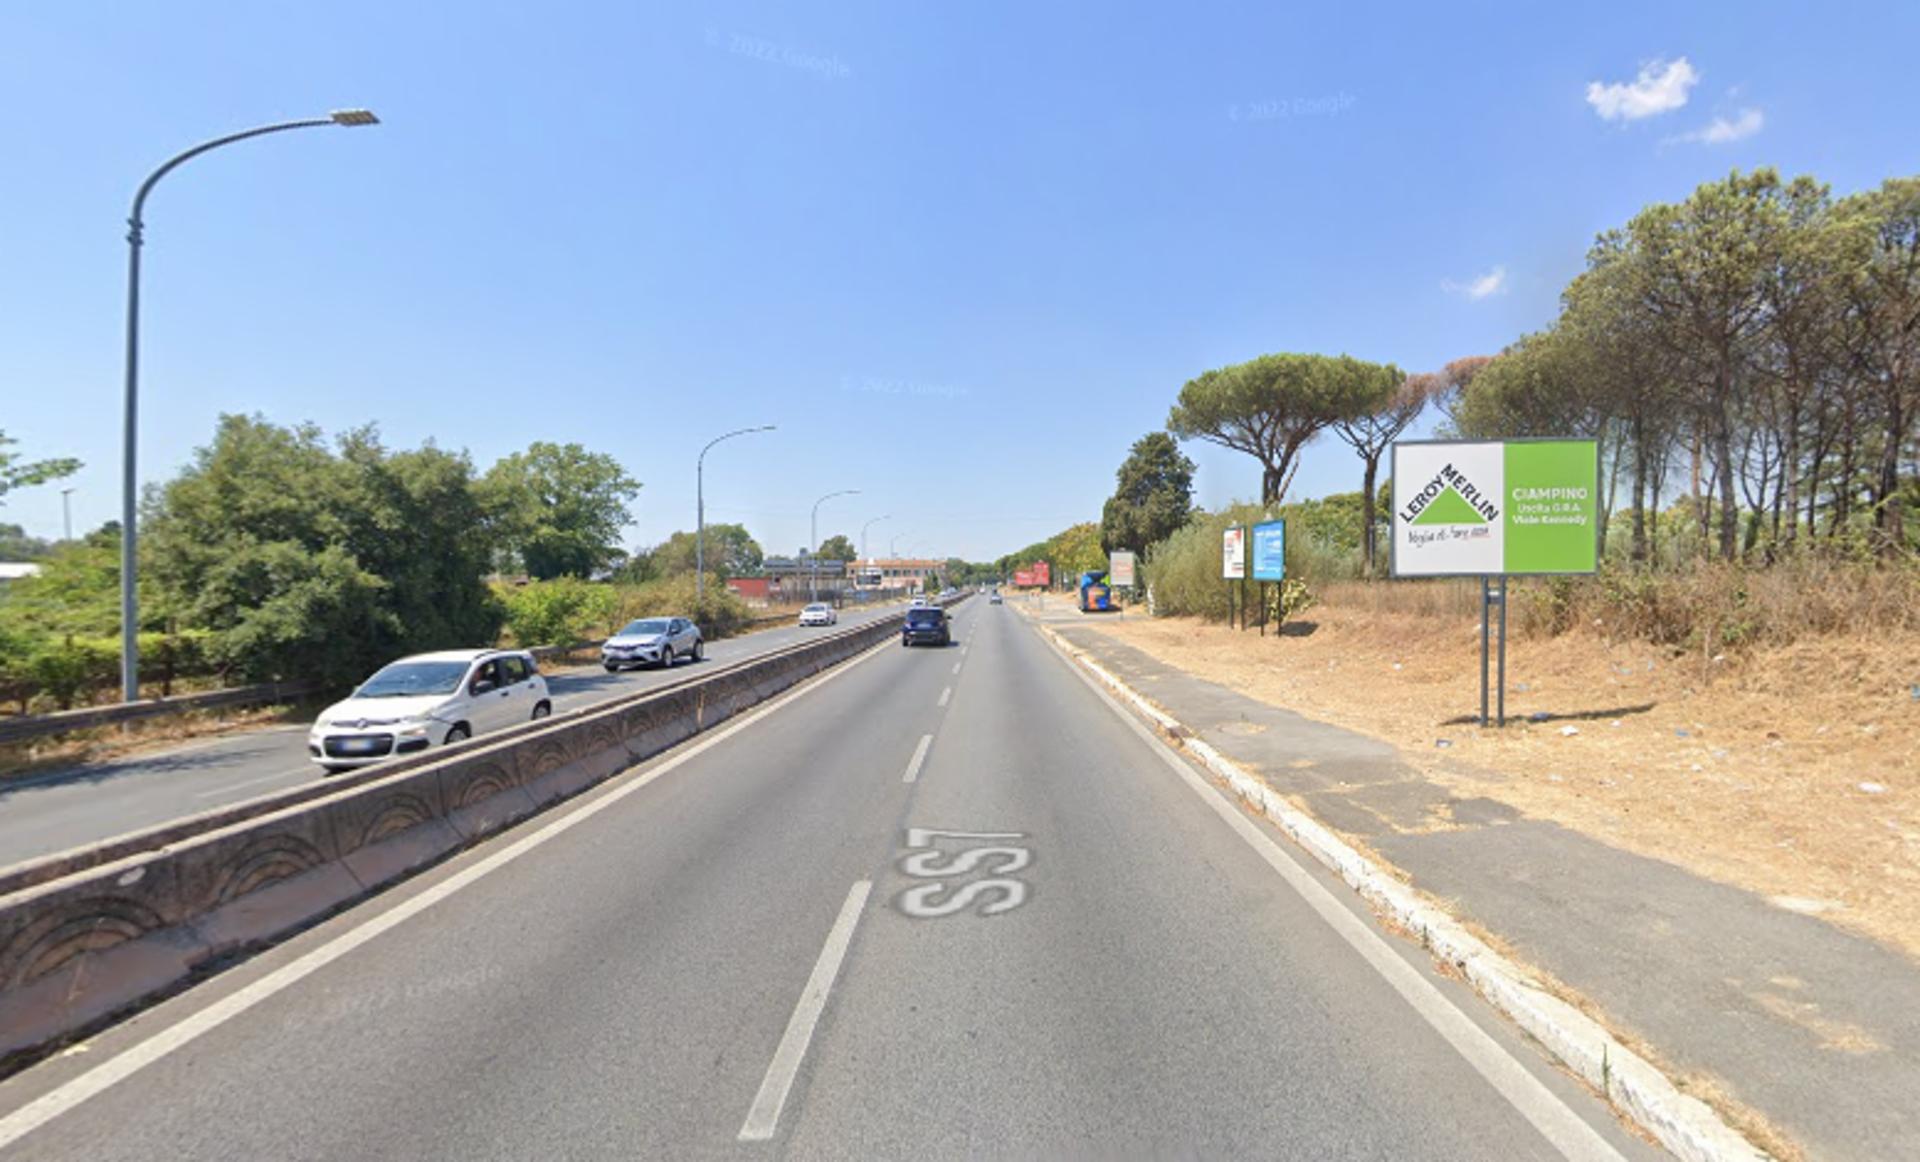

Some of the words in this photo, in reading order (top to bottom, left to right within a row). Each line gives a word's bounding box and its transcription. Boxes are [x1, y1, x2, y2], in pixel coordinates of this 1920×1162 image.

[1399, 475, 1445, 523] LEROY
[1440, 463, 1500, 522] MERLIN
[1512, 487, 1588, 501] CIAMPINO
